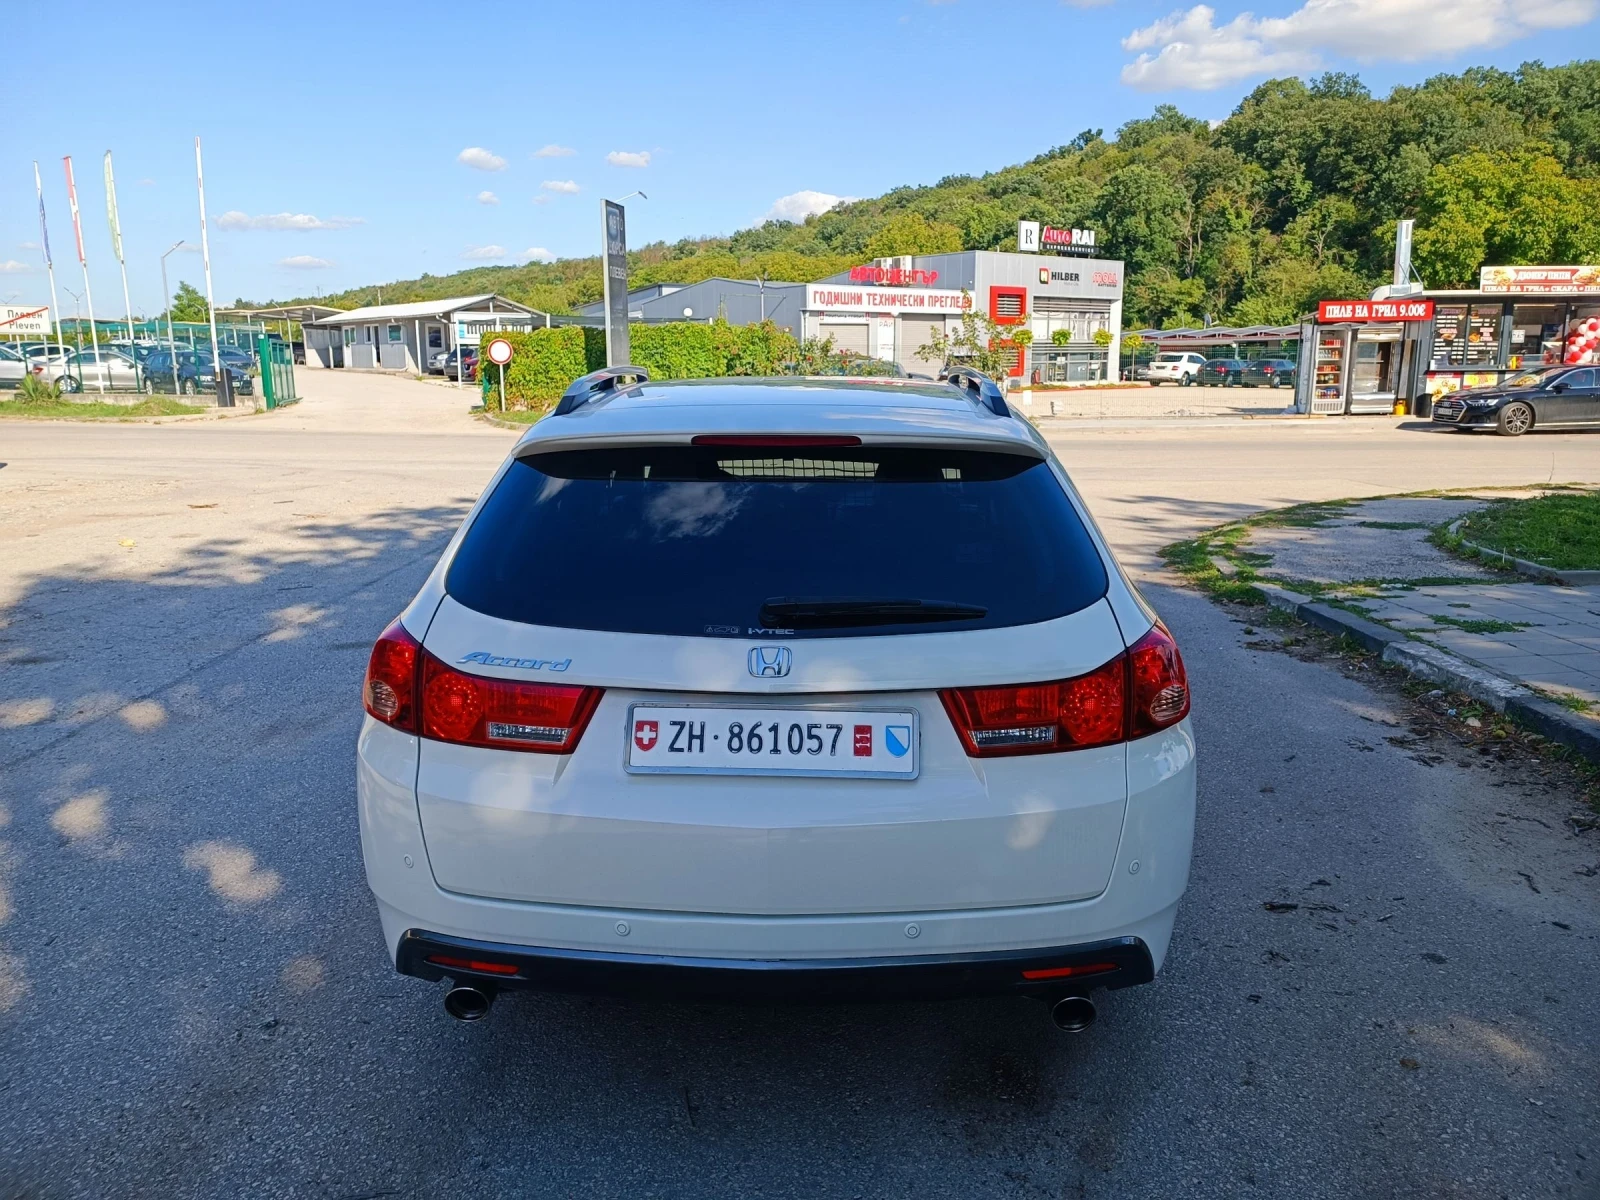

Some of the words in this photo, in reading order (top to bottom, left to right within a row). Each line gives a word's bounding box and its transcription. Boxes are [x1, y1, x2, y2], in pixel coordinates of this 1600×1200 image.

[1025, 228, 1033, 245] R
[849, 265, 939, 285] АВТОЦЕНТЪР
[1051, 271, 1080, 281] HILBER
[813, 291, 863, 307] ГОДИШНИ
[866, 293, 925, 307] ТЕХНИЧЕСКИ
[1325, 305, 1353, 318] ПИЛЕ
[1355, 305, 1369, 317] НА
[1372, 304, 1397, 317] ГРИЛ
[1400, 304, 1426, 316] 9.00€
[9, 320, 41, 330] Pleven
[456, 651, 573, 672] Accord
[727, 721, 843, 757] 861057
